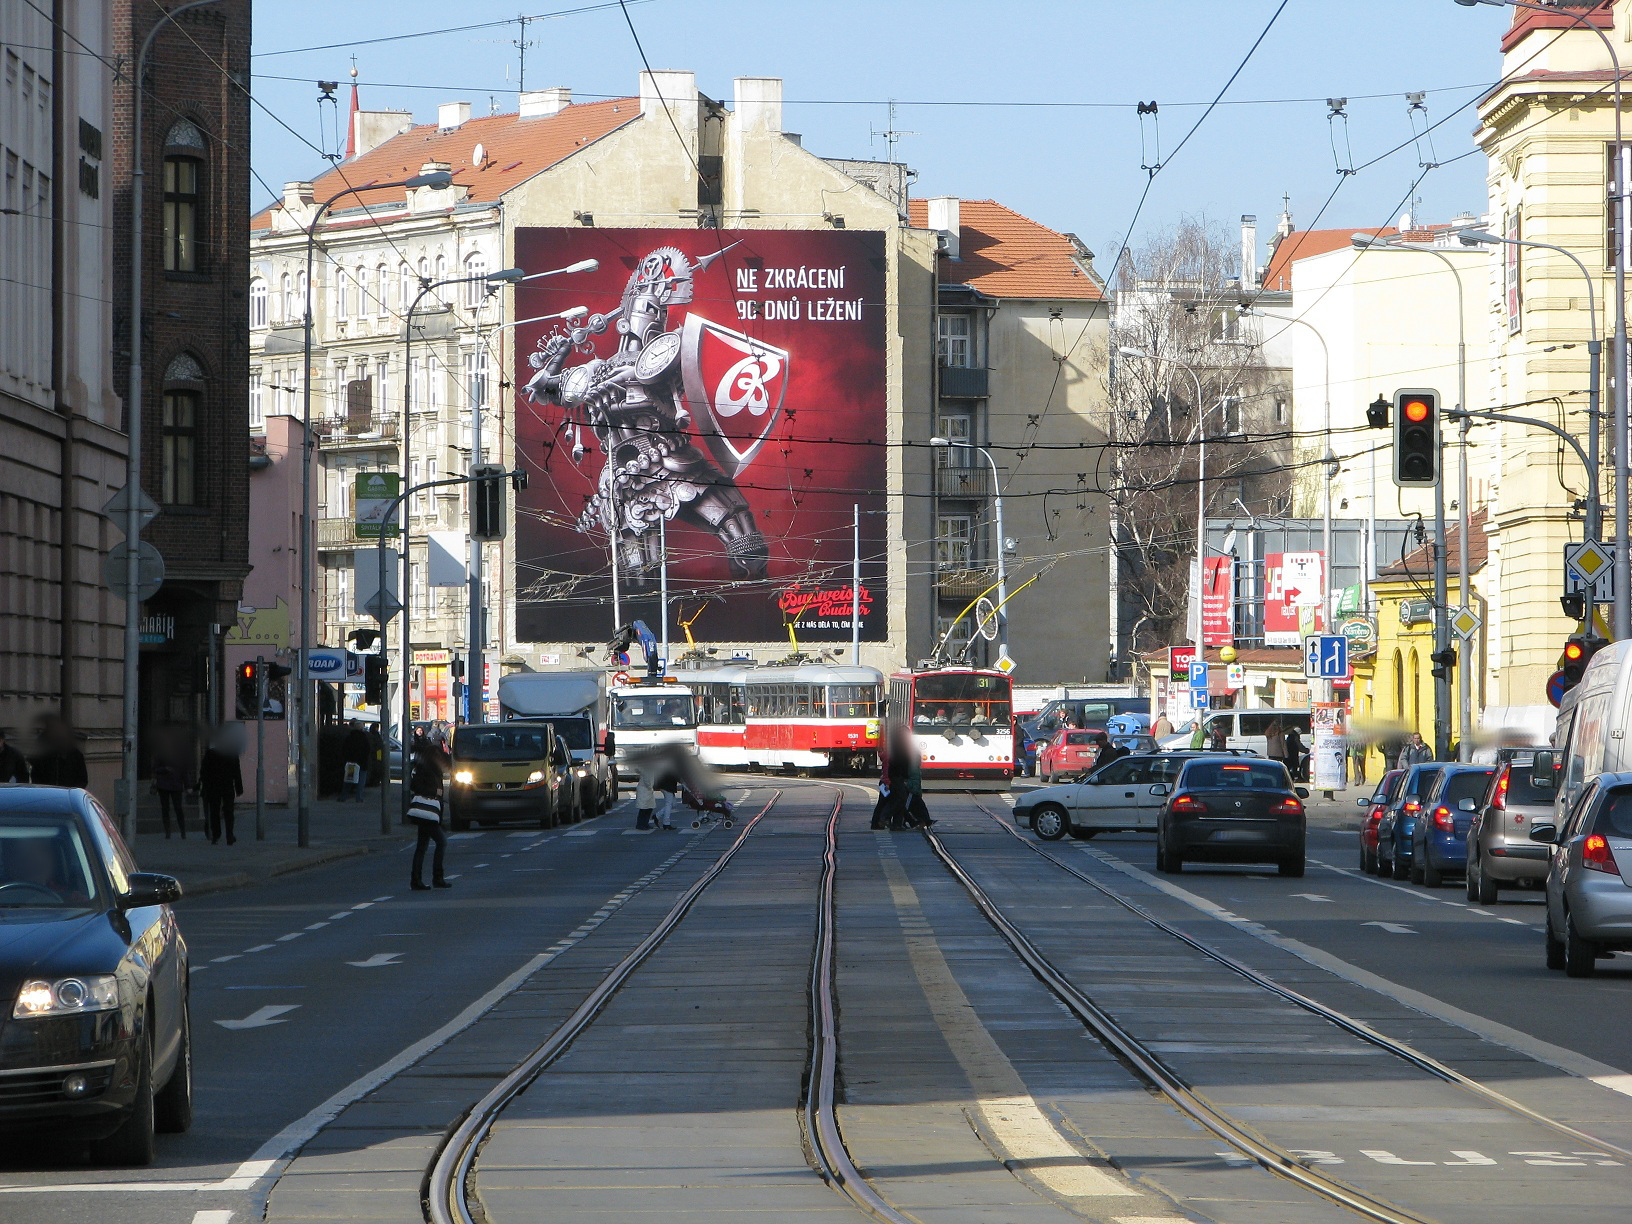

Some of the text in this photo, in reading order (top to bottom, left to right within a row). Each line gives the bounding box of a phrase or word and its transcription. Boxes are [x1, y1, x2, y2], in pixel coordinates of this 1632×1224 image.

[736, 265, 846, 292] NE ZKRÁCENÍ
[737, 296, 864, 321] 90 DNŮ LEŽENÍ
[1267, 567, 1282, 600] JE
[778, 583, 874, 615] Budweisr
[415, 652, 447, 662] POTRAVINY
[978, 678, 989, 688] 31
